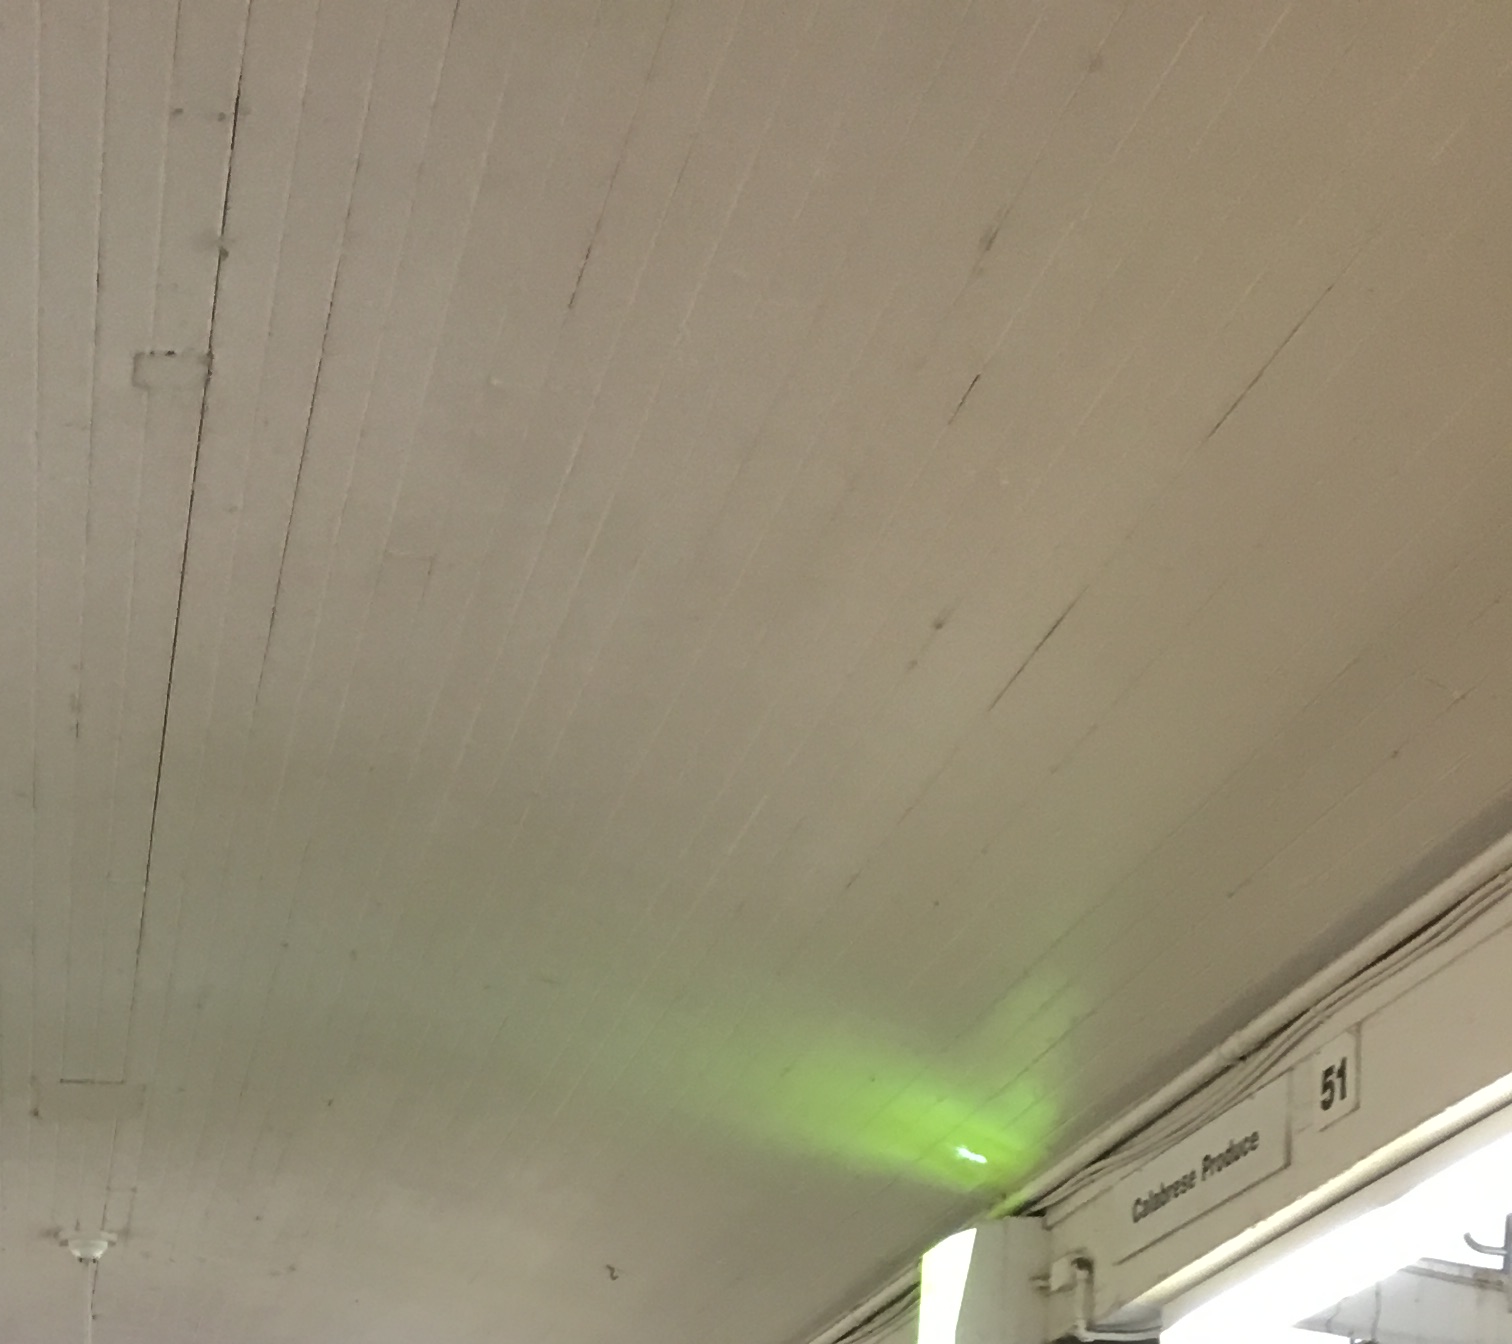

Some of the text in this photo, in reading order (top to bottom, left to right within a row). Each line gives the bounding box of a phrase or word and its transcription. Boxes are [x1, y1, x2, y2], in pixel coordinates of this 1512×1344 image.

[1320, 1056, 1348, 1111] 51
[1131, 1131, 1260, 1224] Calabrese Produce
